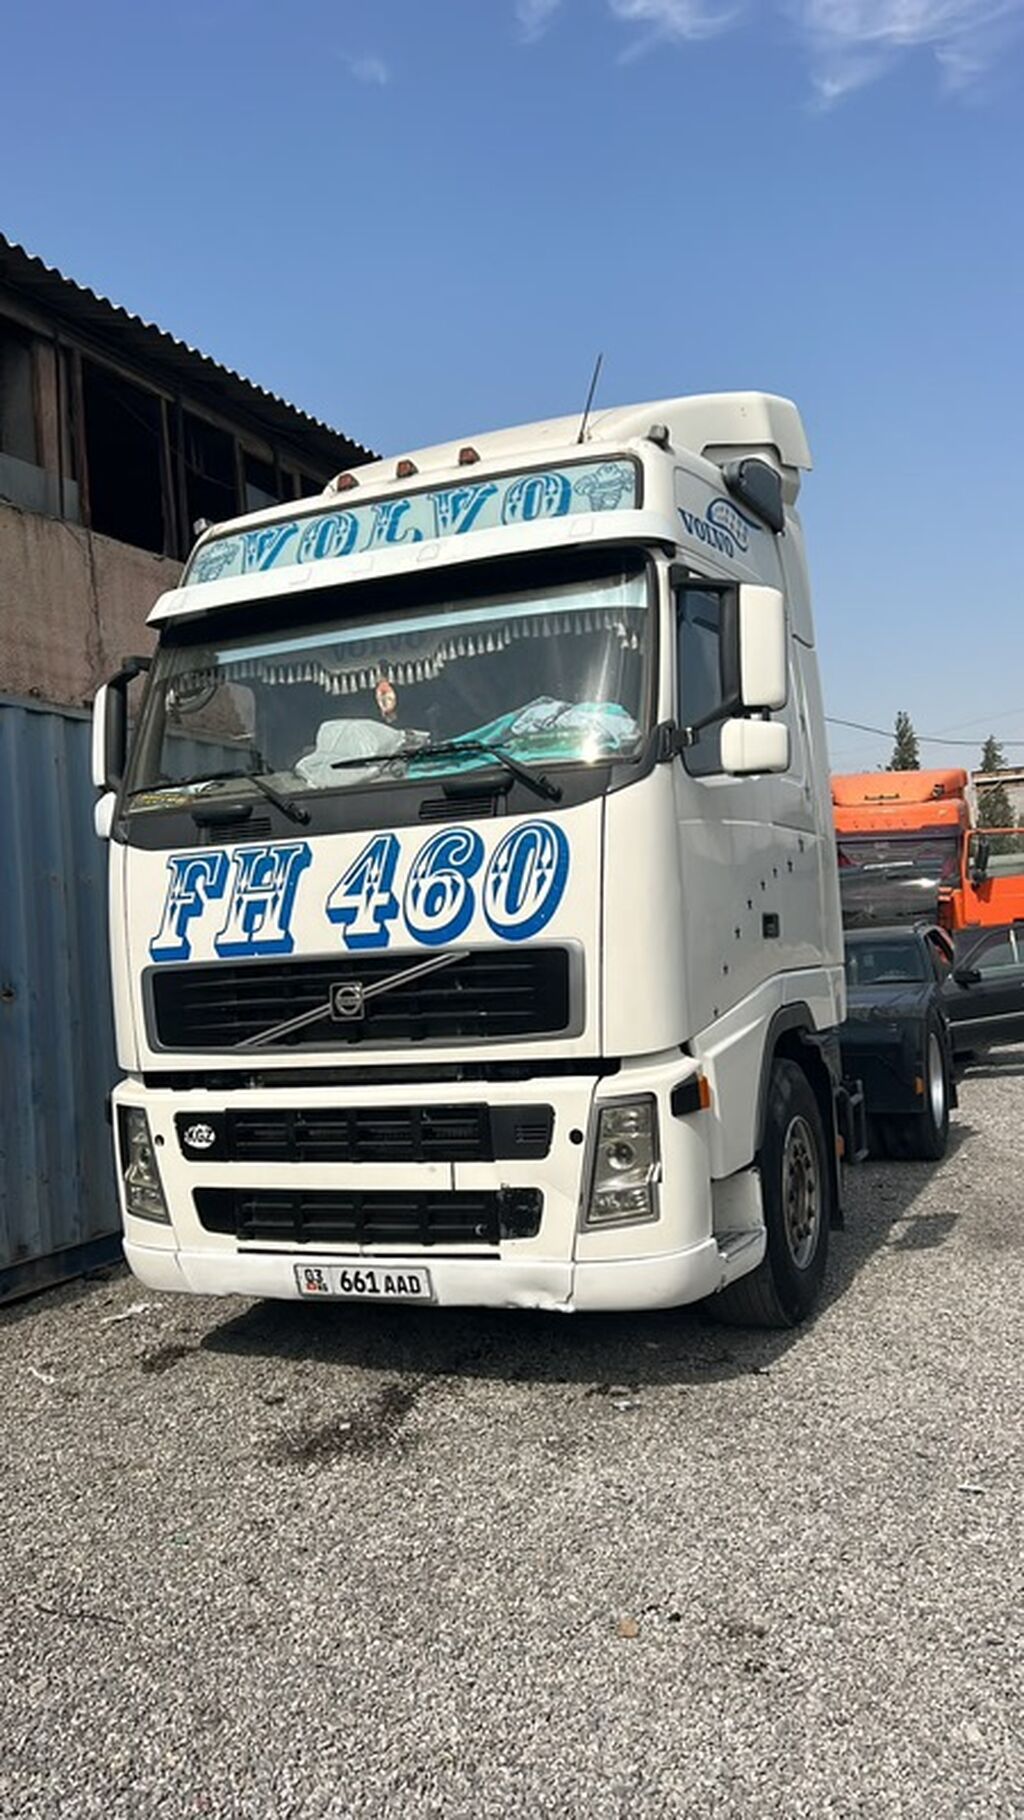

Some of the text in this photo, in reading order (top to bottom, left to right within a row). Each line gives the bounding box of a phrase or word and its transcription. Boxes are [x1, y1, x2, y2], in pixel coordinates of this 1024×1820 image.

[239, 473, 572, 574] VOLVO
[677, 507, 734, 558] VOLVO
[149, 819, 571, 962] FH 460
[304, 1268, 324, 1284] 03
[340, 1270, 381, 1293] 661
[384, 1275, 421, 1294] AAD
